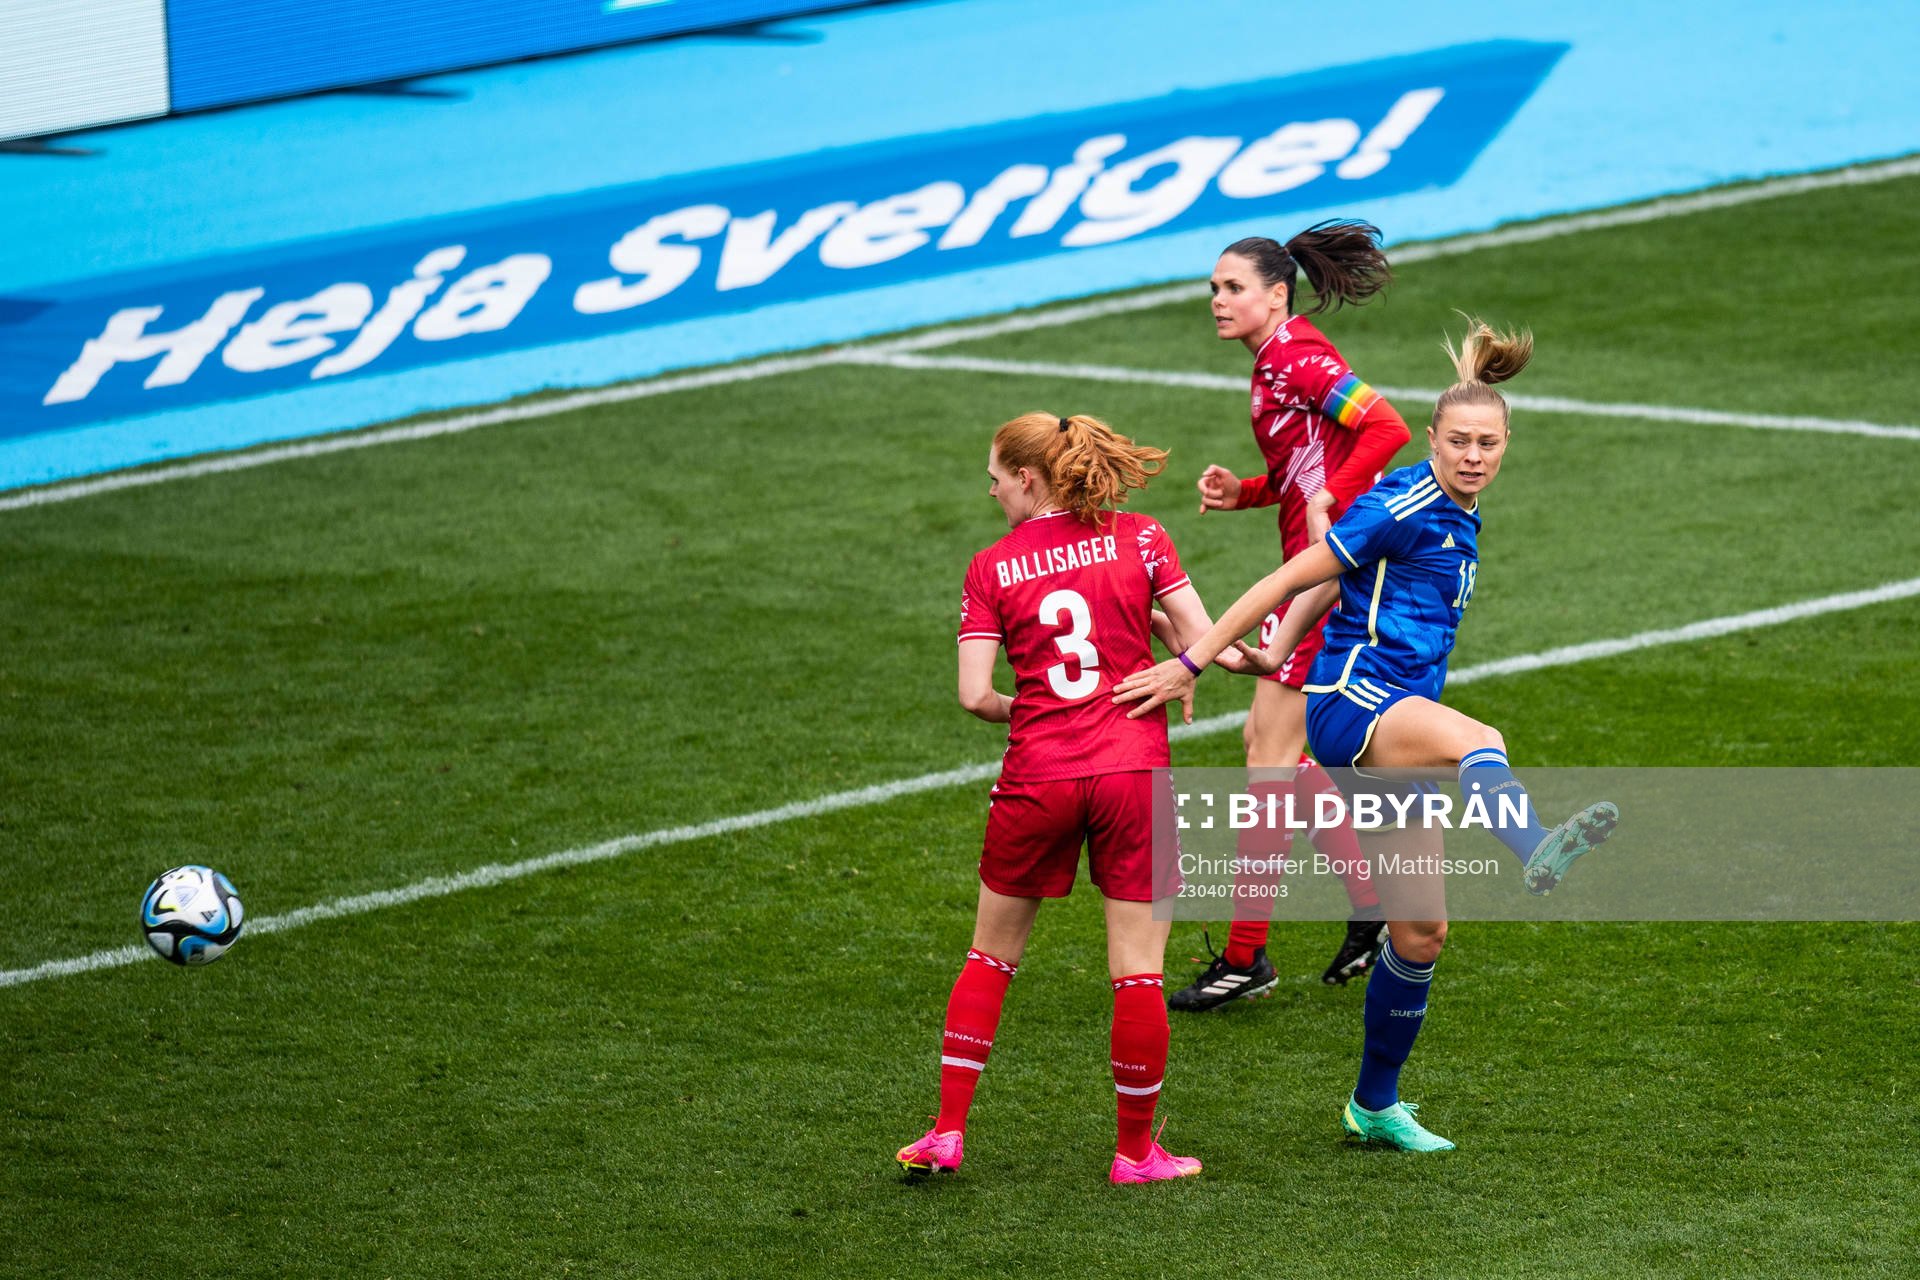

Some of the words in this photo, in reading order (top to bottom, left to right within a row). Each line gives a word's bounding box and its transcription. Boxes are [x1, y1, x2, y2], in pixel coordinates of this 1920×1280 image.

[45, 246, 551, 405] Heja
[574, 89, 1443, 313] Sverige!
[996, 534, 1119, 588] BALLISAGER
[1452, 559, 1478, 609] 18
[1038, 588, 1100, 700] 3
